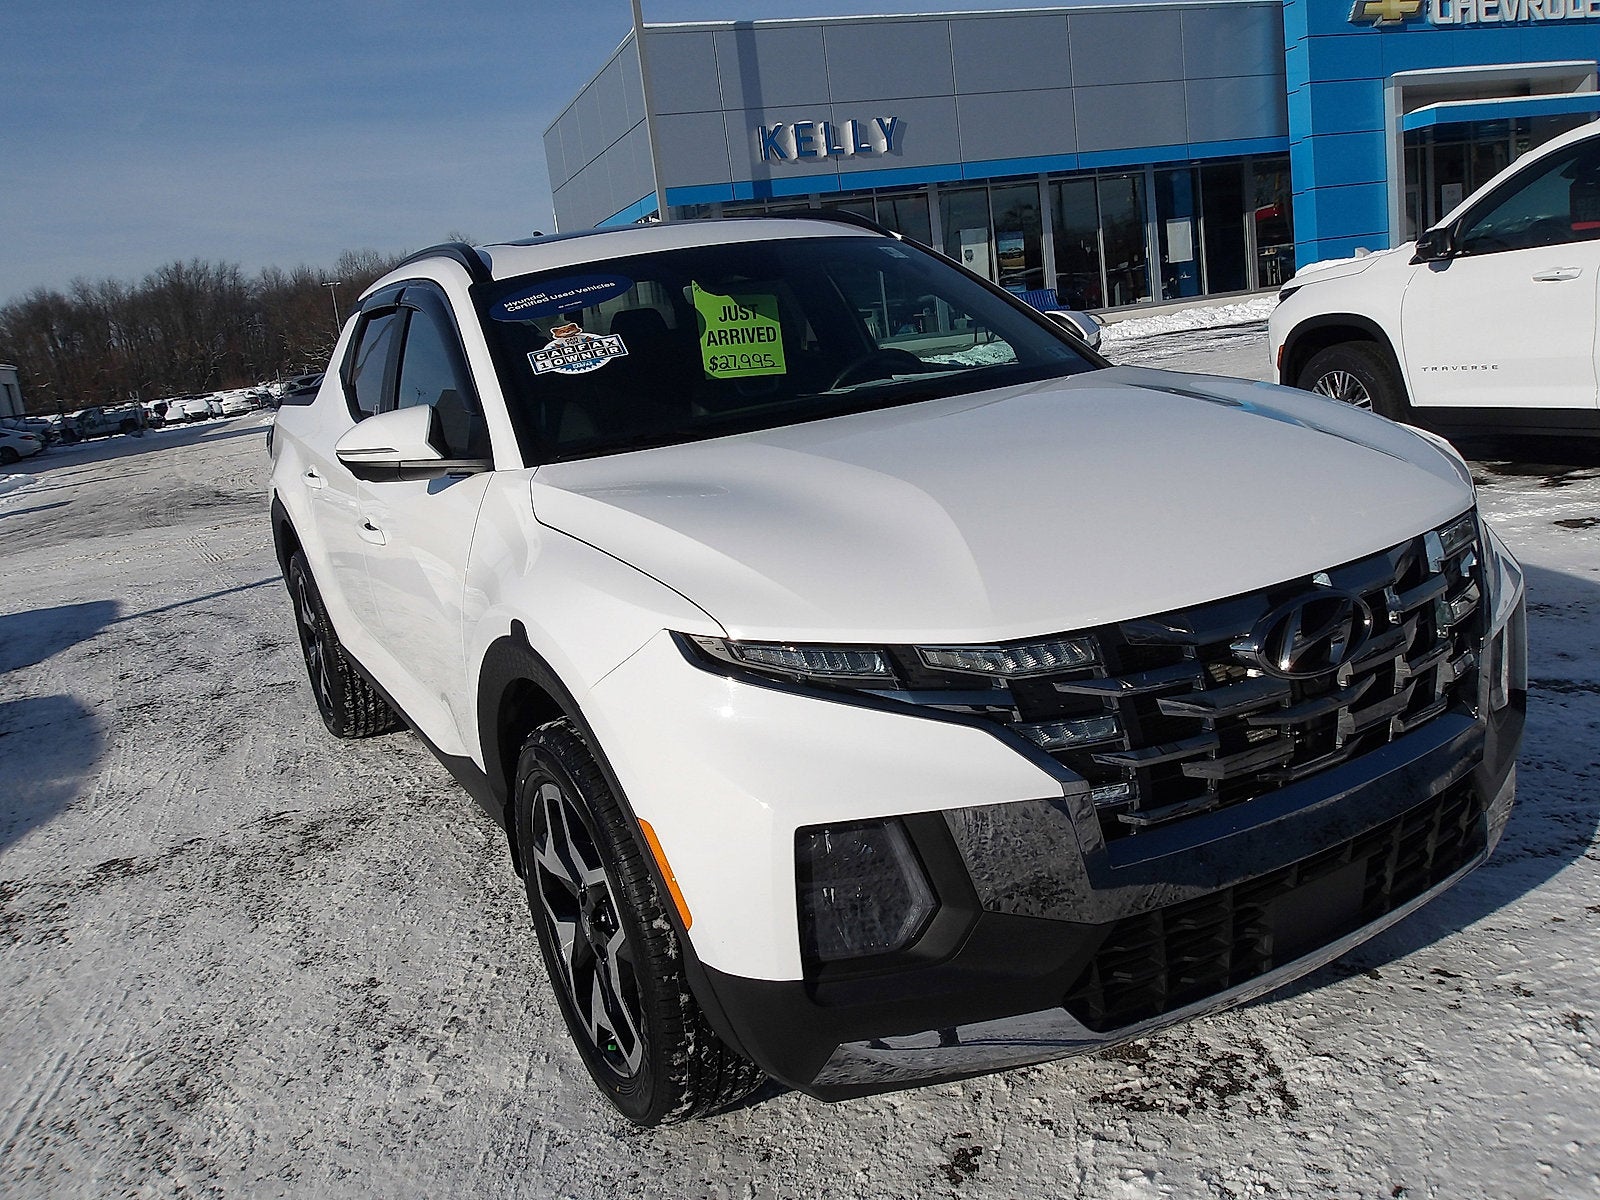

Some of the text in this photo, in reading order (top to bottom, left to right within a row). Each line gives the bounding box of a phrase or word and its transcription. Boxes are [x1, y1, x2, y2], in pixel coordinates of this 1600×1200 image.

[757, 116, 899, 161] KELLY
[503, 292, 546, 308] Hyundai
[507, 298, 549, 312] Certified
[550, 290, 576, 300] Used
[575, 281, 616, 294] Vehicles
[719, 304, 758, 322] JUST
[707, 326, 777, 347] ARRIVED
[535, 339, 616, 360] CARFAX
[540, 359, 549, 370] 1
[552, 347, 620, 366] OWNER
[1421, 364, 1499, 372] TRAVERSE
